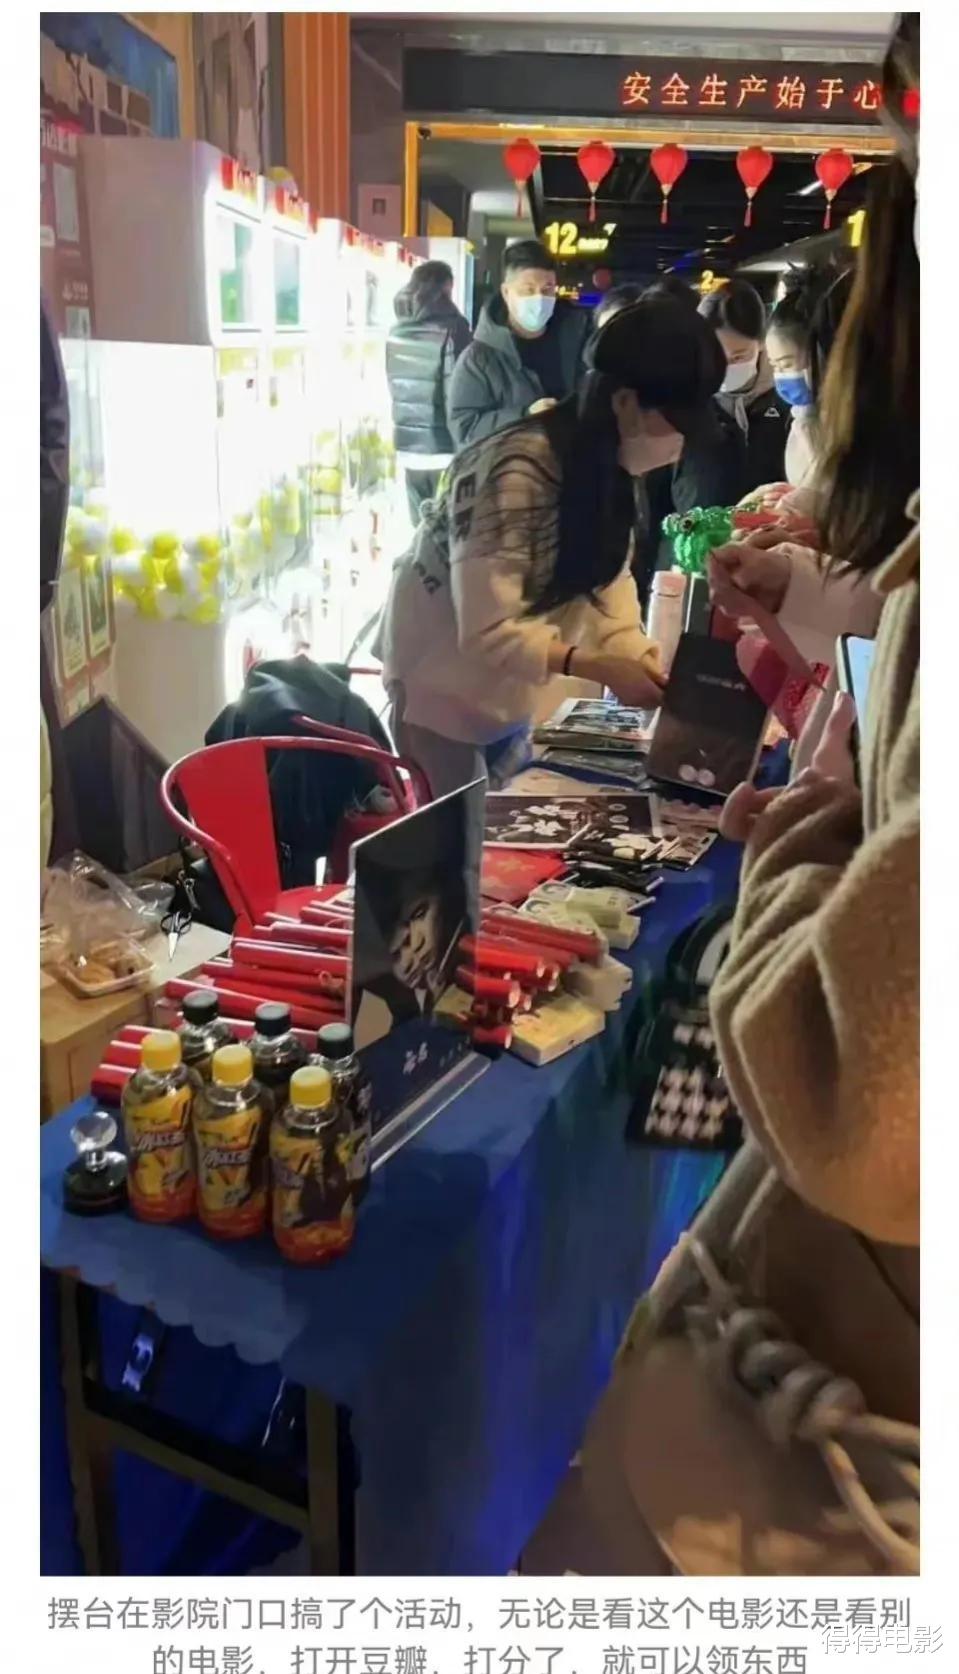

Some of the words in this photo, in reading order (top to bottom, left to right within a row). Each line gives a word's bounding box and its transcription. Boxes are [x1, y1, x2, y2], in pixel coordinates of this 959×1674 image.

[622, 72, 881, 111] 安全生产始于心
[545, 221, 578, 254] 12
